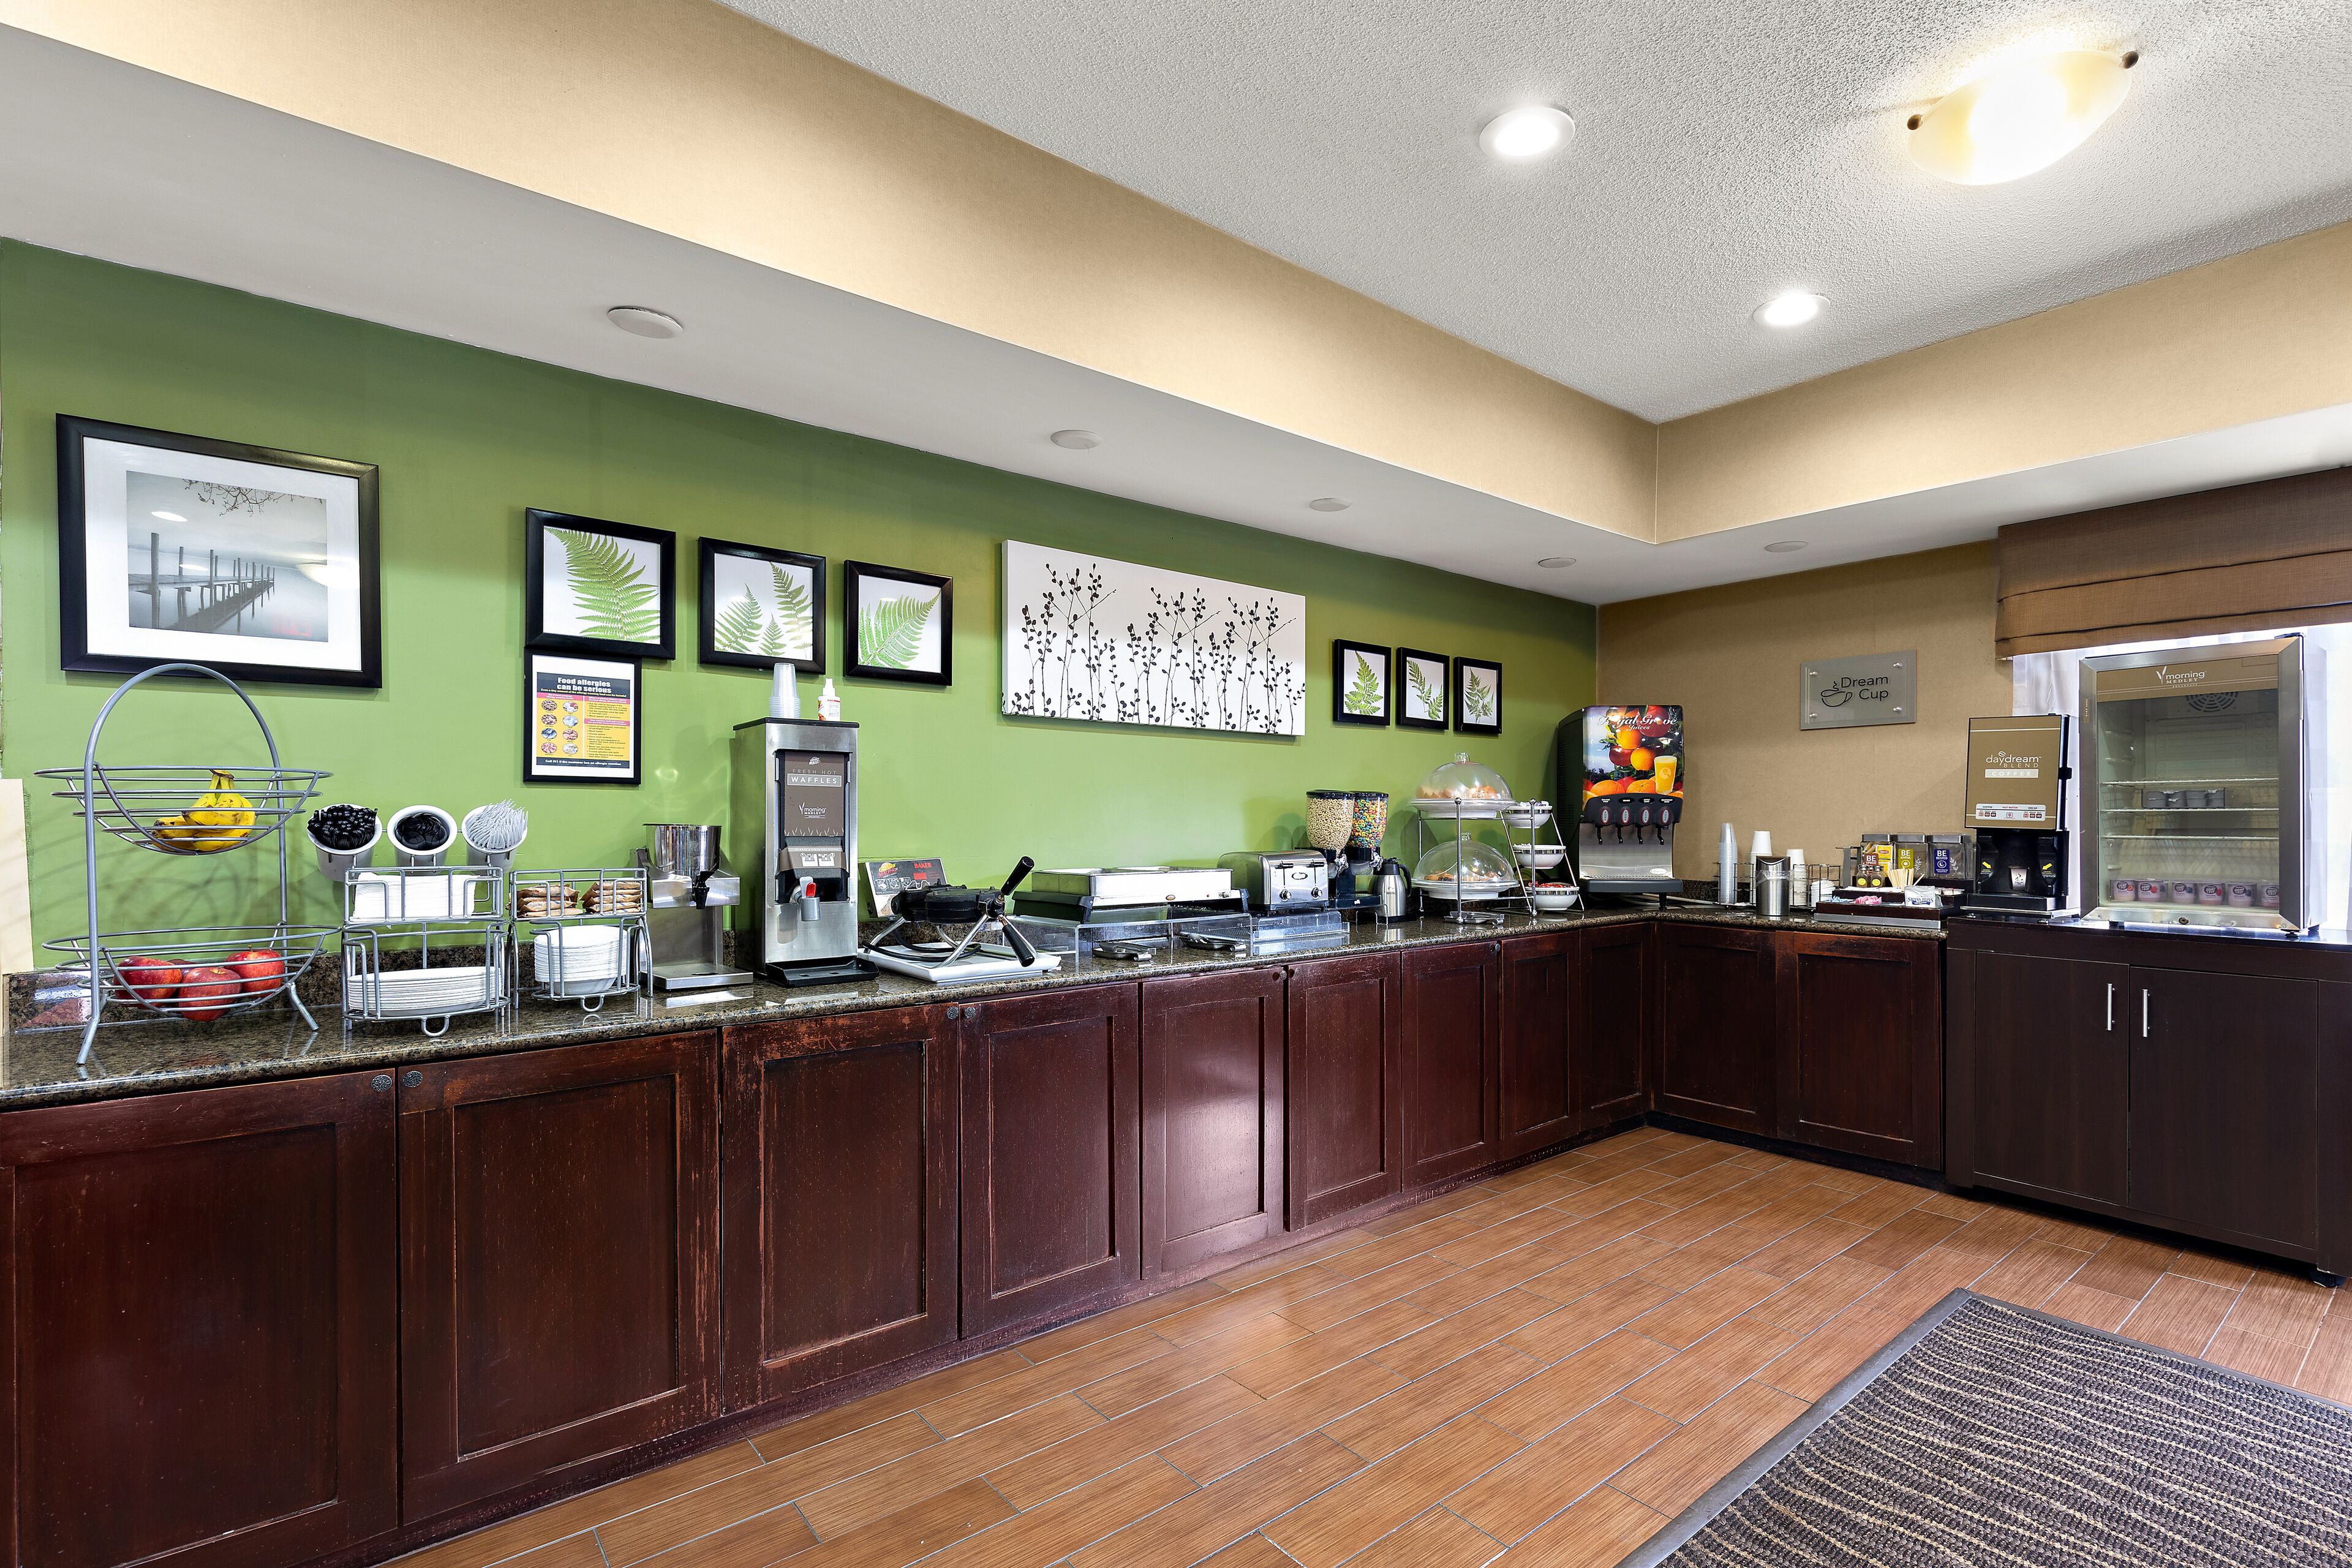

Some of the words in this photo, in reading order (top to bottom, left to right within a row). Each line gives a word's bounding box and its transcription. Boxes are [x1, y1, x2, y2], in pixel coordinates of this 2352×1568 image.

[2166, 671, 2205, 680] morning
[577, 679, 611, 687] allergies
[1841, 676, 1888, 688] Dream
[1859, 688, 1888, 701] Cup
[1986, 754, 2039, 766] daydream
